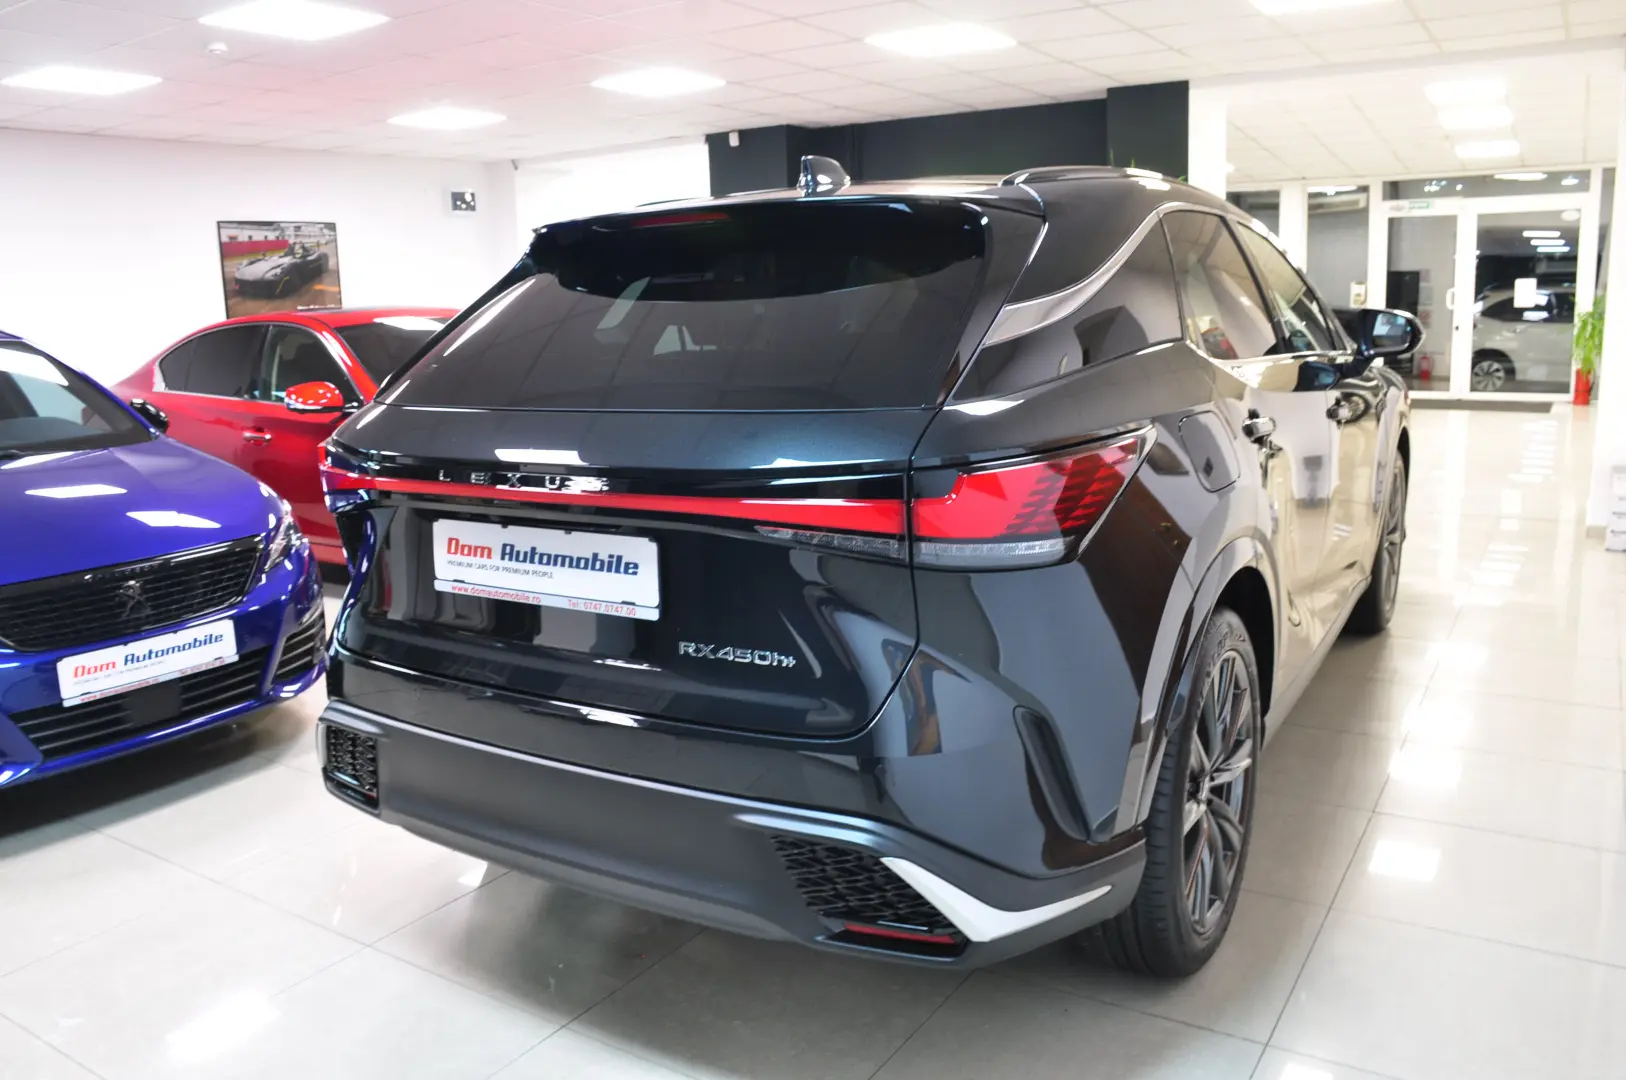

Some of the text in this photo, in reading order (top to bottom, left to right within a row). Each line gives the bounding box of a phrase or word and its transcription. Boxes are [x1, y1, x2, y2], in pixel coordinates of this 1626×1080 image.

[446, 536, 640, 576] Dom Automobile
[447, 559, 554, 579] PREMIUM CARS FOR PREMIUM PEOPLE
[451, 585, 542, 604] www.domautomobile.ro
[73, 660, 117, 679] Dom
[123, 633, 224, 667] Automobile
[679, 641, 797, 668] RX450h+
